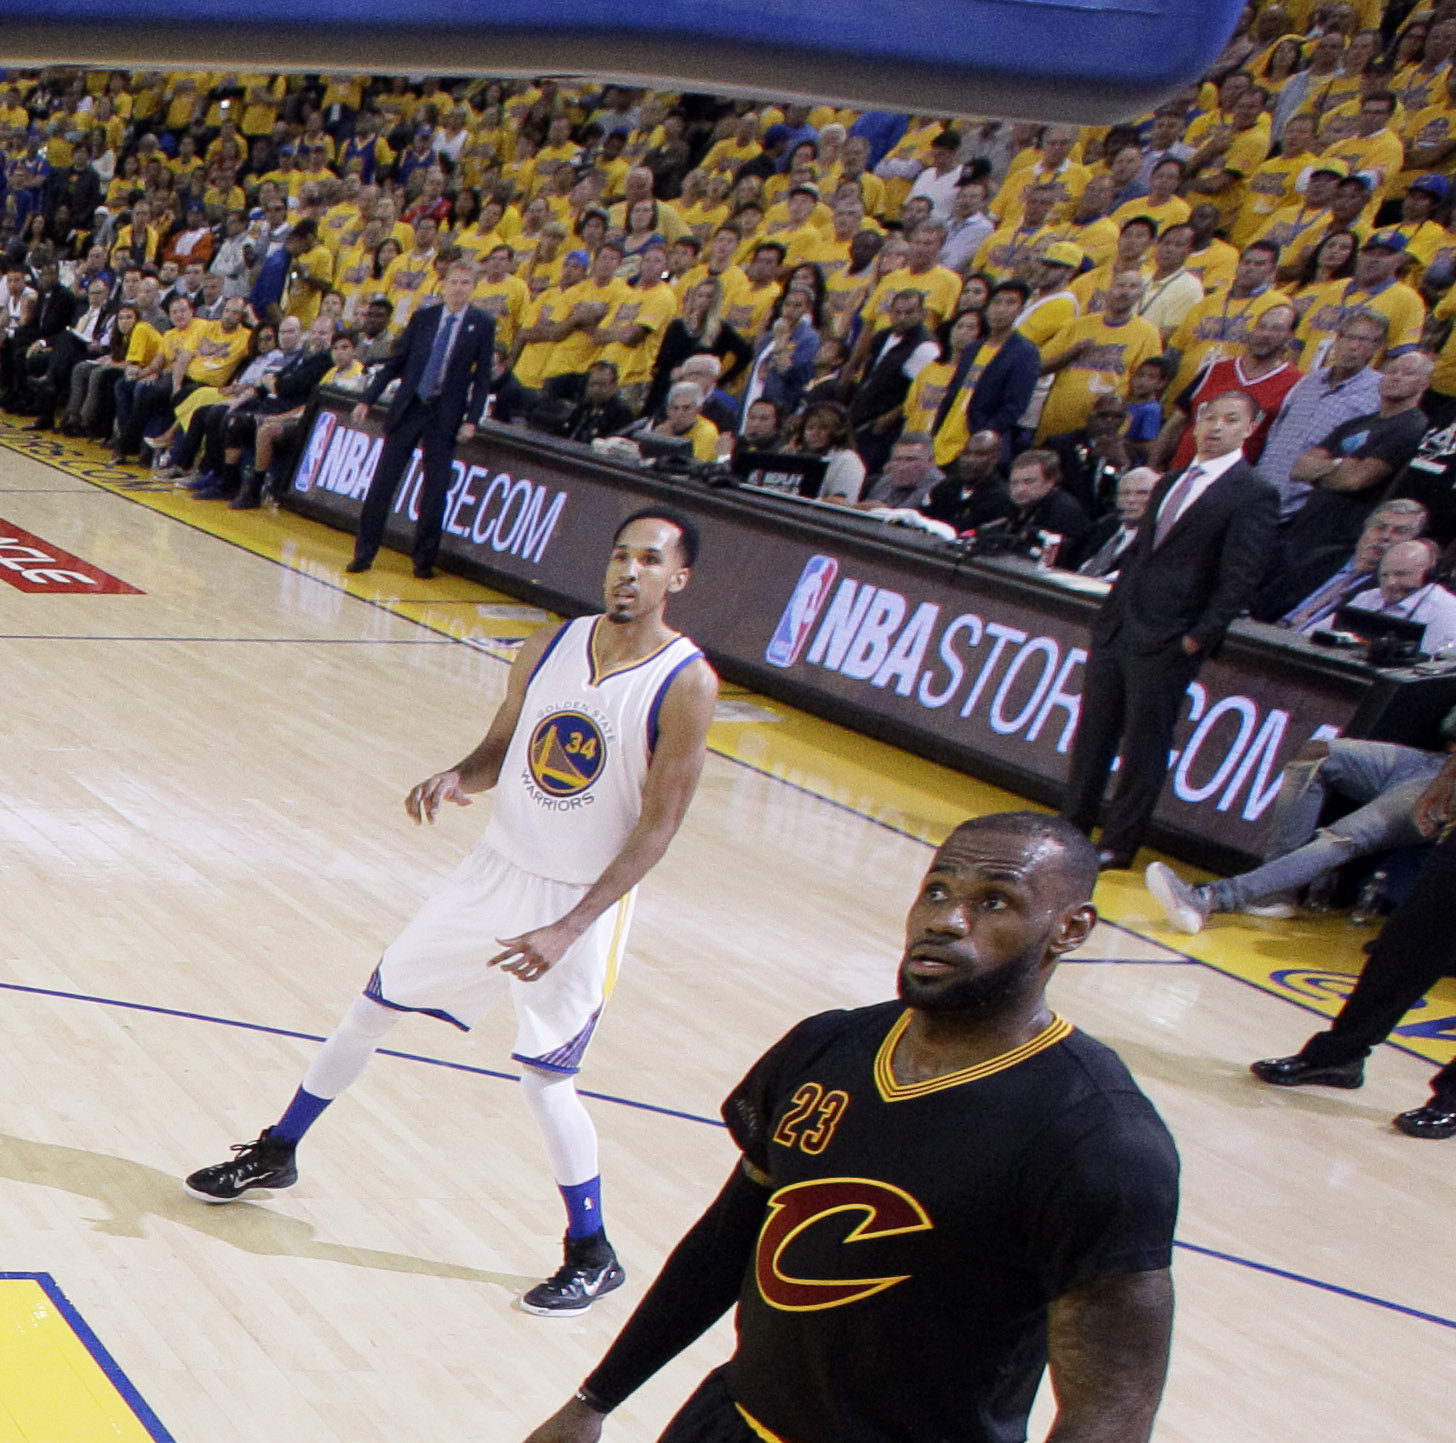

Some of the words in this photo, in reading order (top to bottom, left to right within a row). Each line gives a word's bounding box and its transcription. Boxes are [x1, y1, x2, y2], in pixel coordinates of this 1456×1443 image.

[537, 699, 590, 720] GOLDEN
[592, 708, 617, 744] STATE
[564, 731, 598, 760] 34
[520, 767, 595, 813] WARRIORS
[772, 1081, 850, 1156] 23
